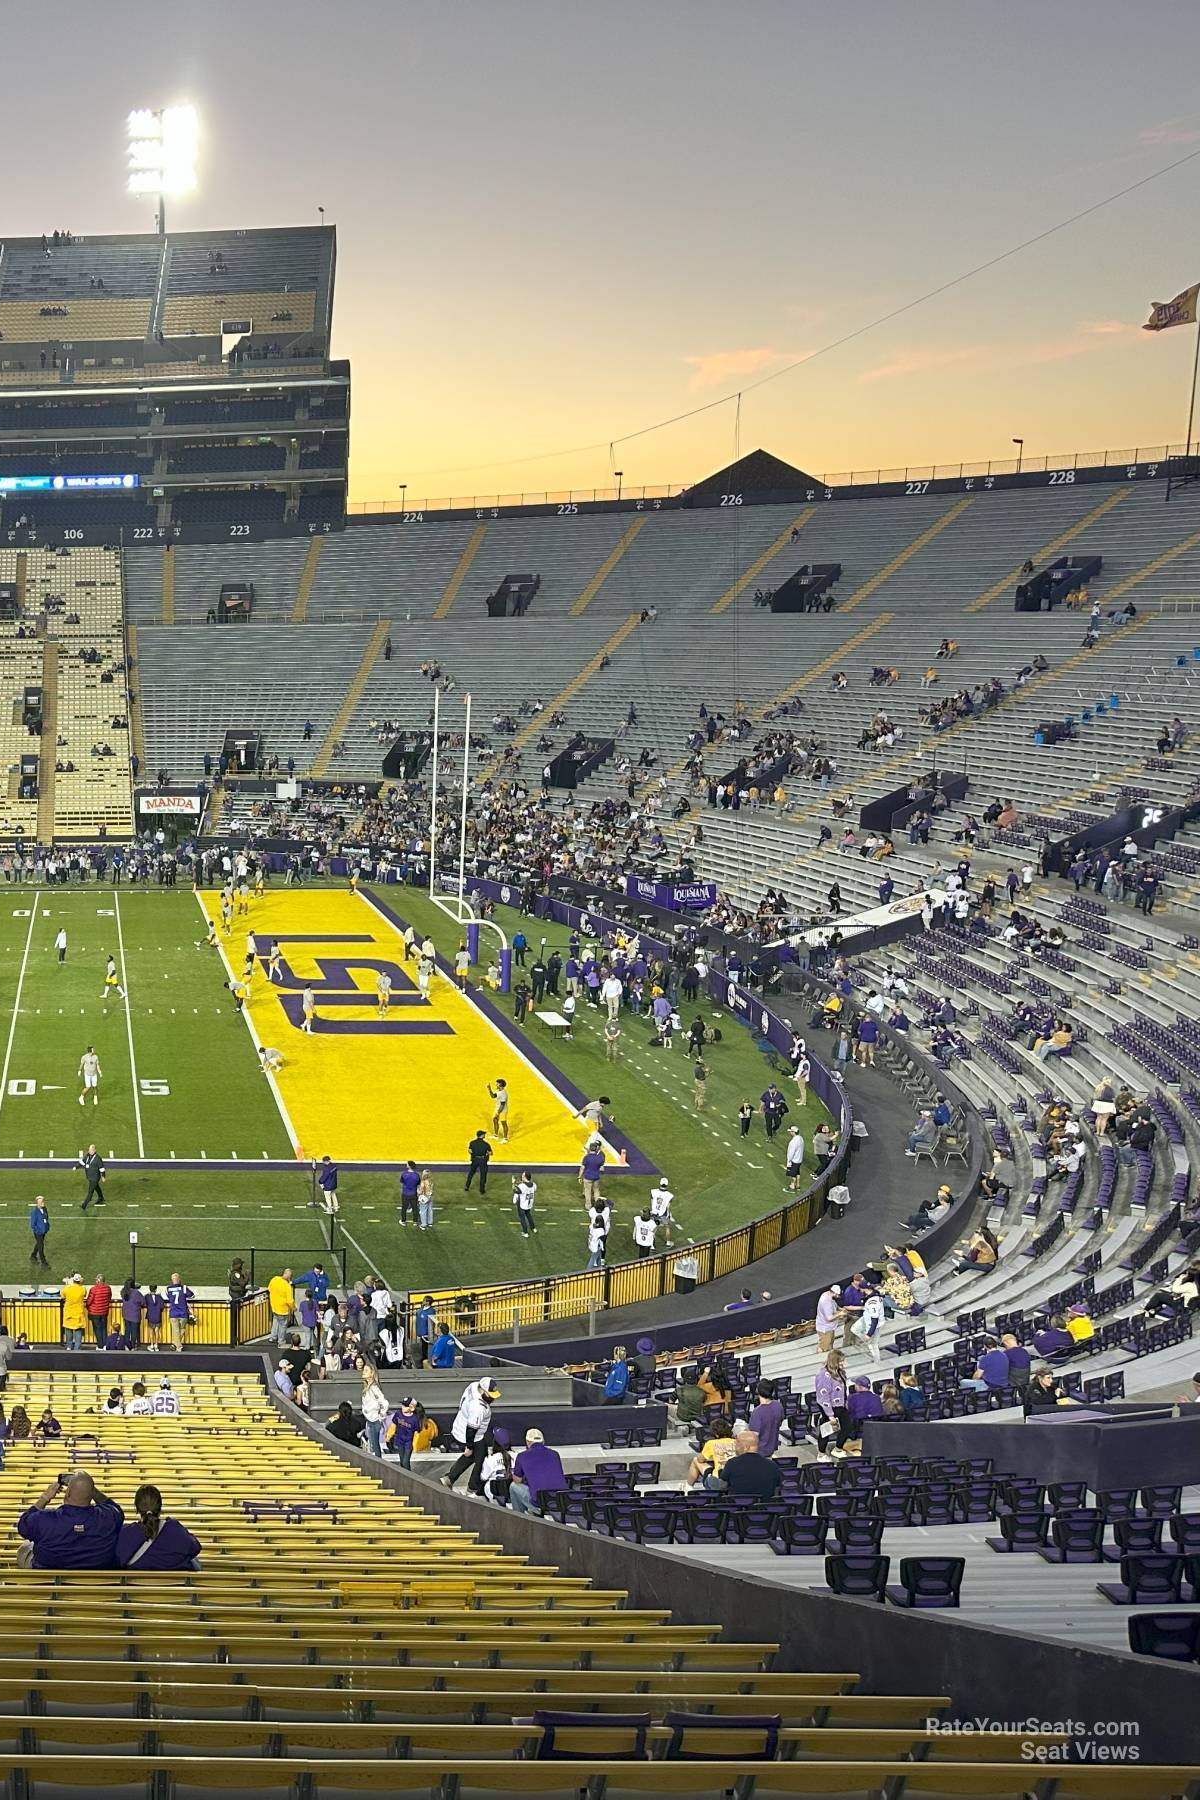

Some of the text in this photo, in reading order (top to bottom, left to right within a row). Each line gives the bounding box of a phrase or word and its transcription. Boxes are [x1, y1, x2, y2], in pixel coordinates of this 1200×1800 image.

[1049, 470, 1076, 485] 228
[906, 482, 930, 495] 227
[720, 494, 743, 507] 226
[557, 503, 578, 516] 225
[402, 512, 424, 524] 224
[63, 529, 84, 540] 106
[133, 528, 153, 539] 222
[230, 525, 250, 536] 223
[145, 797, 195, 810] MANDA
[673, 886, 710, 902] LOUISIANA
[140, 1080, 170, 1096] 5
[172, 1292, 180, 1304] 7
[155, 1396, 175, 1414] 25
